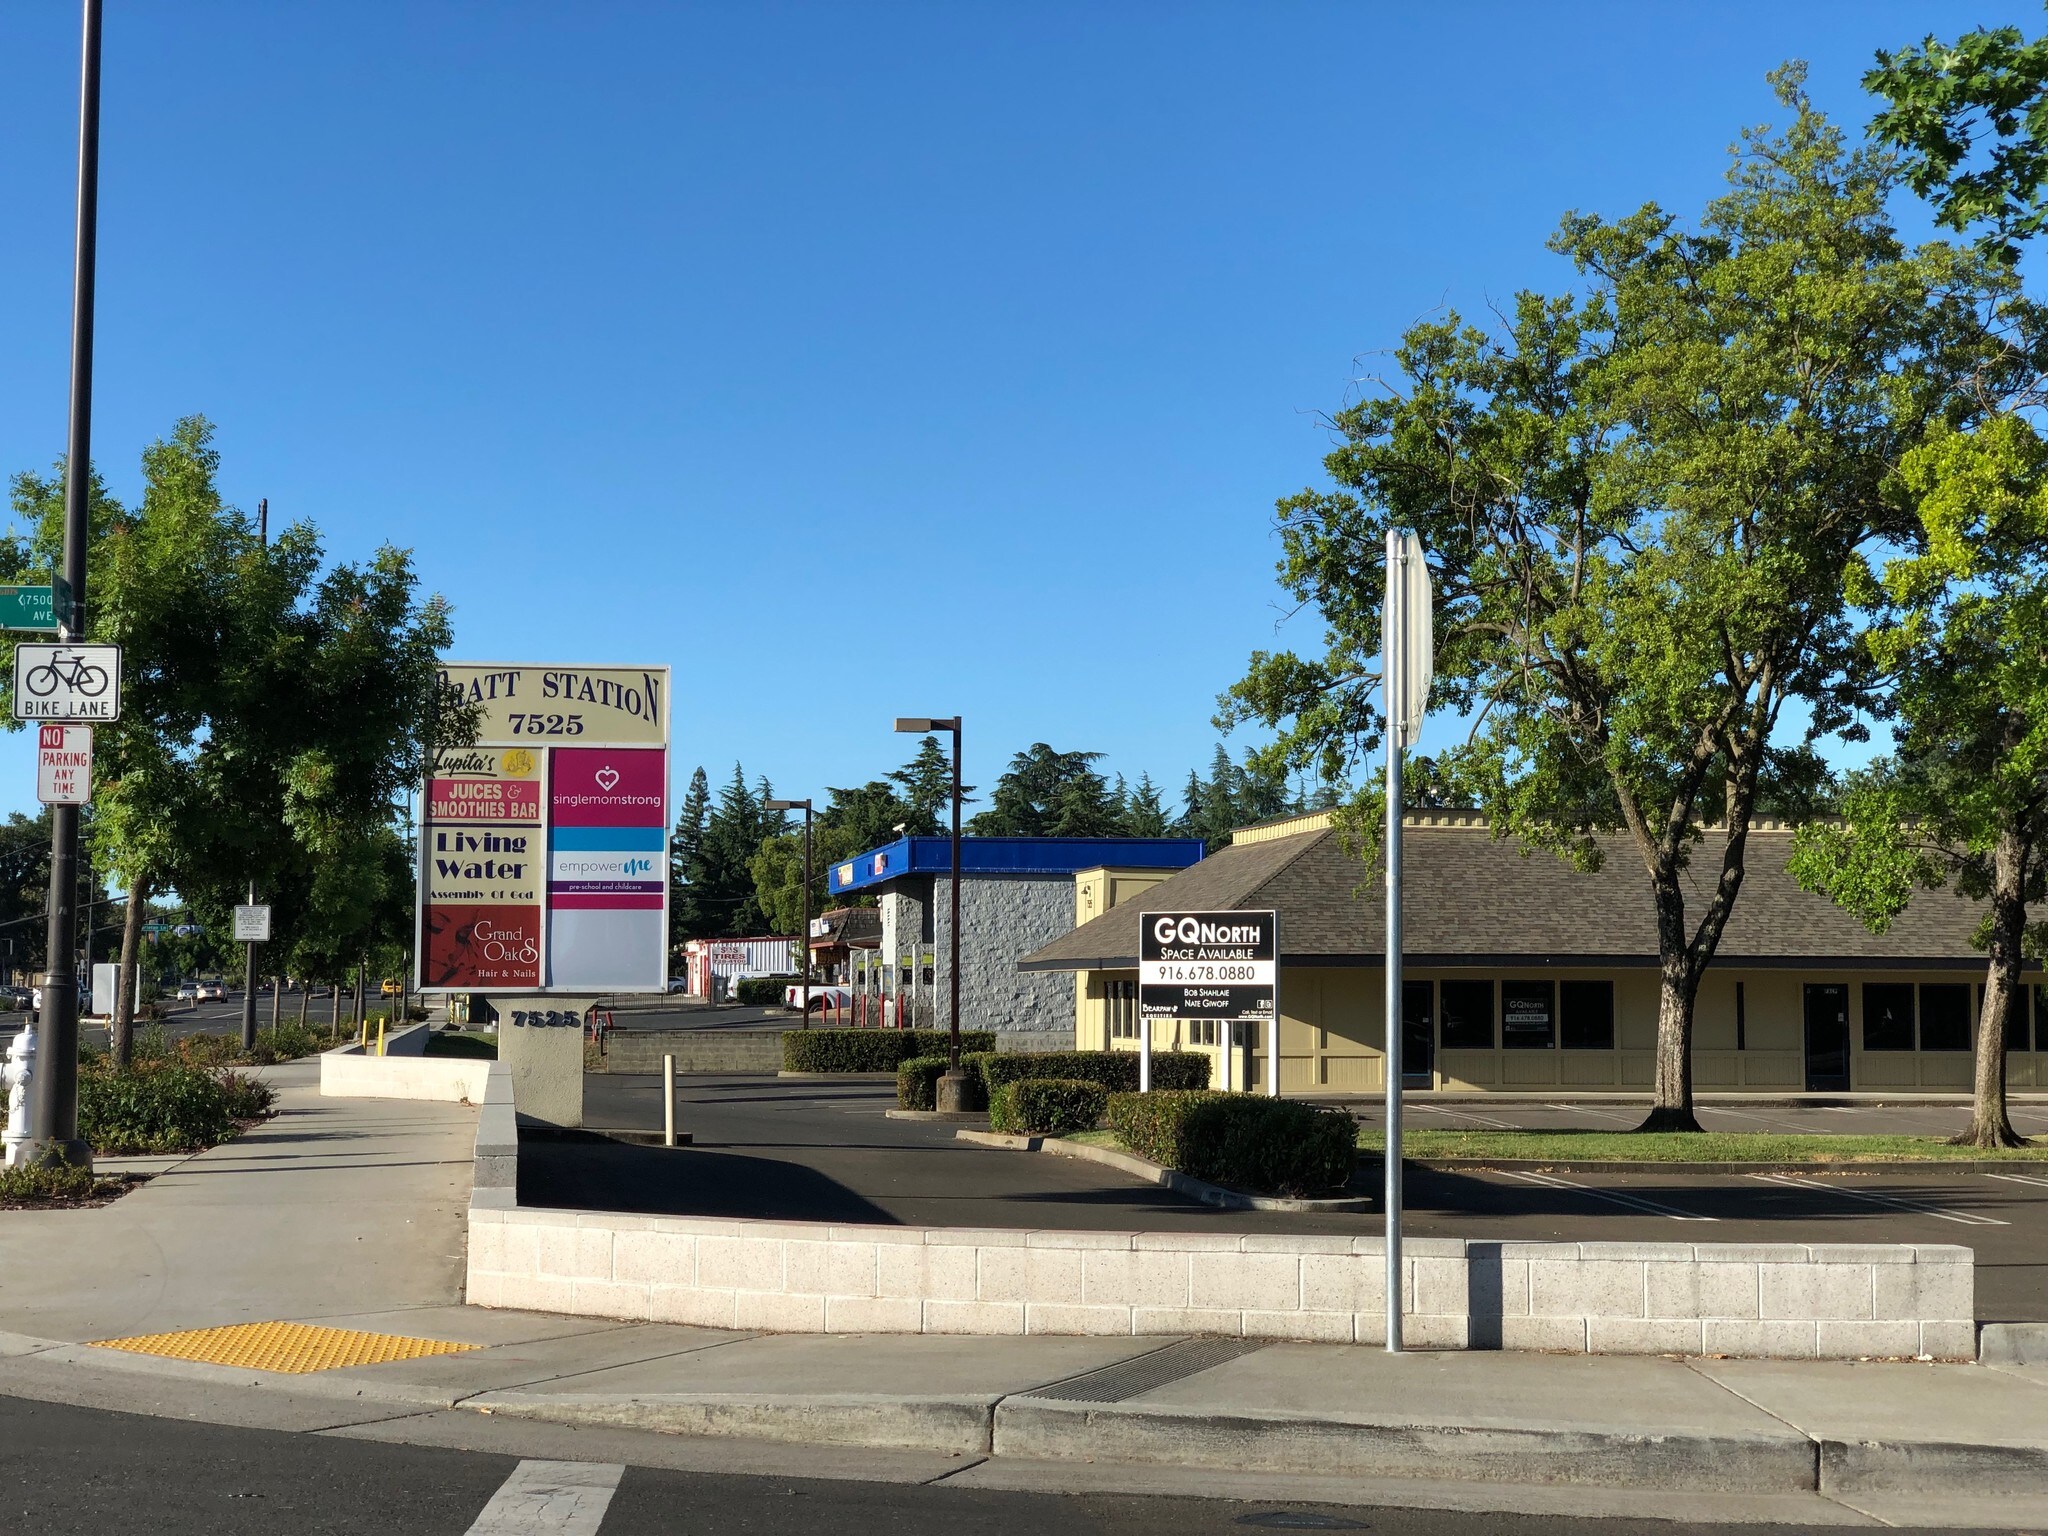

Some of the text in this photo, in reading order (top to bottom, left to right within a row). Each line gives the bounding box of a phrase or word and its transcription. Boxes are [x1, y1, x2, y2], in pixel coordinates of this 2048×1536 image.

[33, 611, 52, 621] AVE
[542, 671, 659, 728] STATION
[25, 702, 109, 716] BIKE LANE
[508, 714, 584, 735] 7525
[43, 729, 61, 746] NO
[43, 752, 87, 767] PARKING
[433, 747, 495, 777] Lupita's
[54, 769, 74, 780] ANY
[53, 783, 75, 794] TIME
[449, 783, 522, 800] JUICES &
[553, 794, 661, 807] singlemomstrong
[429, 801, 537, 818] SMOOTHIES BAR
[437, 832, 527, 854] Living
[435, 859, 528, 880] Water
[569, 882, 601, 892] pre-school
[614, 882, 642, 890] childcare
[430, 890, 533, 899] Assembly Of God
[474, 920, 522, 940] Grand
[1161, 947, 1254, 960] SPACE AVAILABLE
[478, 969, 536, 977] Hair & Nails
[1159, 966, 1255, 980] 916.678.0880
[1184, 988, 1198, 996] BOB
[1184, 999, 1201, 1007] NATE
[511, 1010, 578, 1028] 7525
